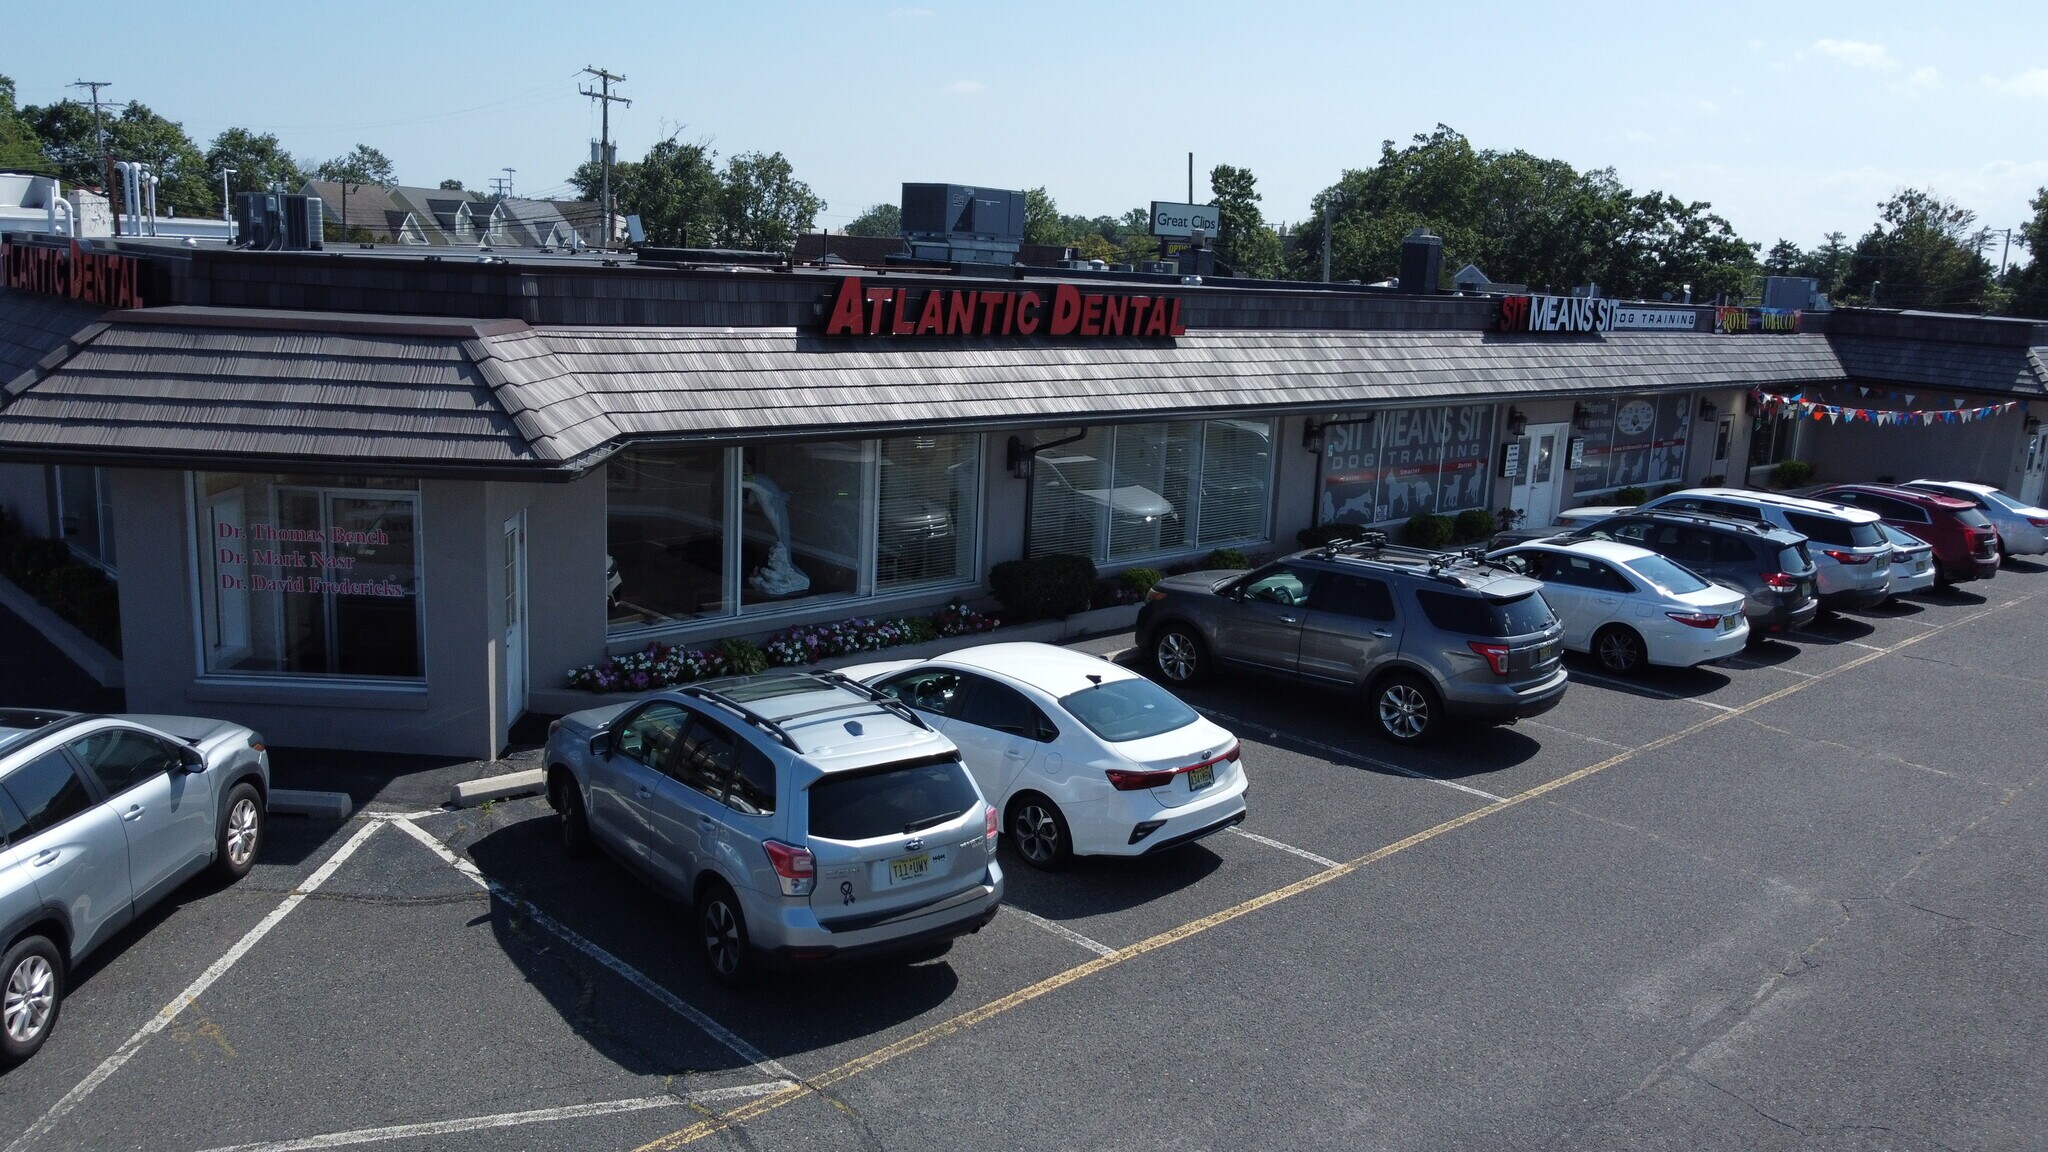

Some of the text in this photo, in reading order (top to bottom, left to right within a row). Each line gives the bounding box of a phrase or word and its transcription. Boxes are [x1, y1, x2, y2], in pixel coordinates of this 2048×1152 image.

[1157, 213, 1216, 230] Great Clips
[70, 239, 144, 309] DENTAL
[825, 276, 1186, 336] ATLANTIC DENTAL
[1501, 296, 1620, 332] SIT MEANS SIT
[1642, 313, 1695, 325] TRAINING
[1723, 312, 1795, 333] ROYAL TOBACCO
[1333, 406, 1488, 453] SIT MEANS SIT
[1332, 443, 1480, 471] DOG TRAINING
[218, 522, 389, 545] Dr. Thomas Bench
[219, 548, 356, 570] Dr. Mark Nasr
[221, 574, 404, 597] Dr. David Fredericks
